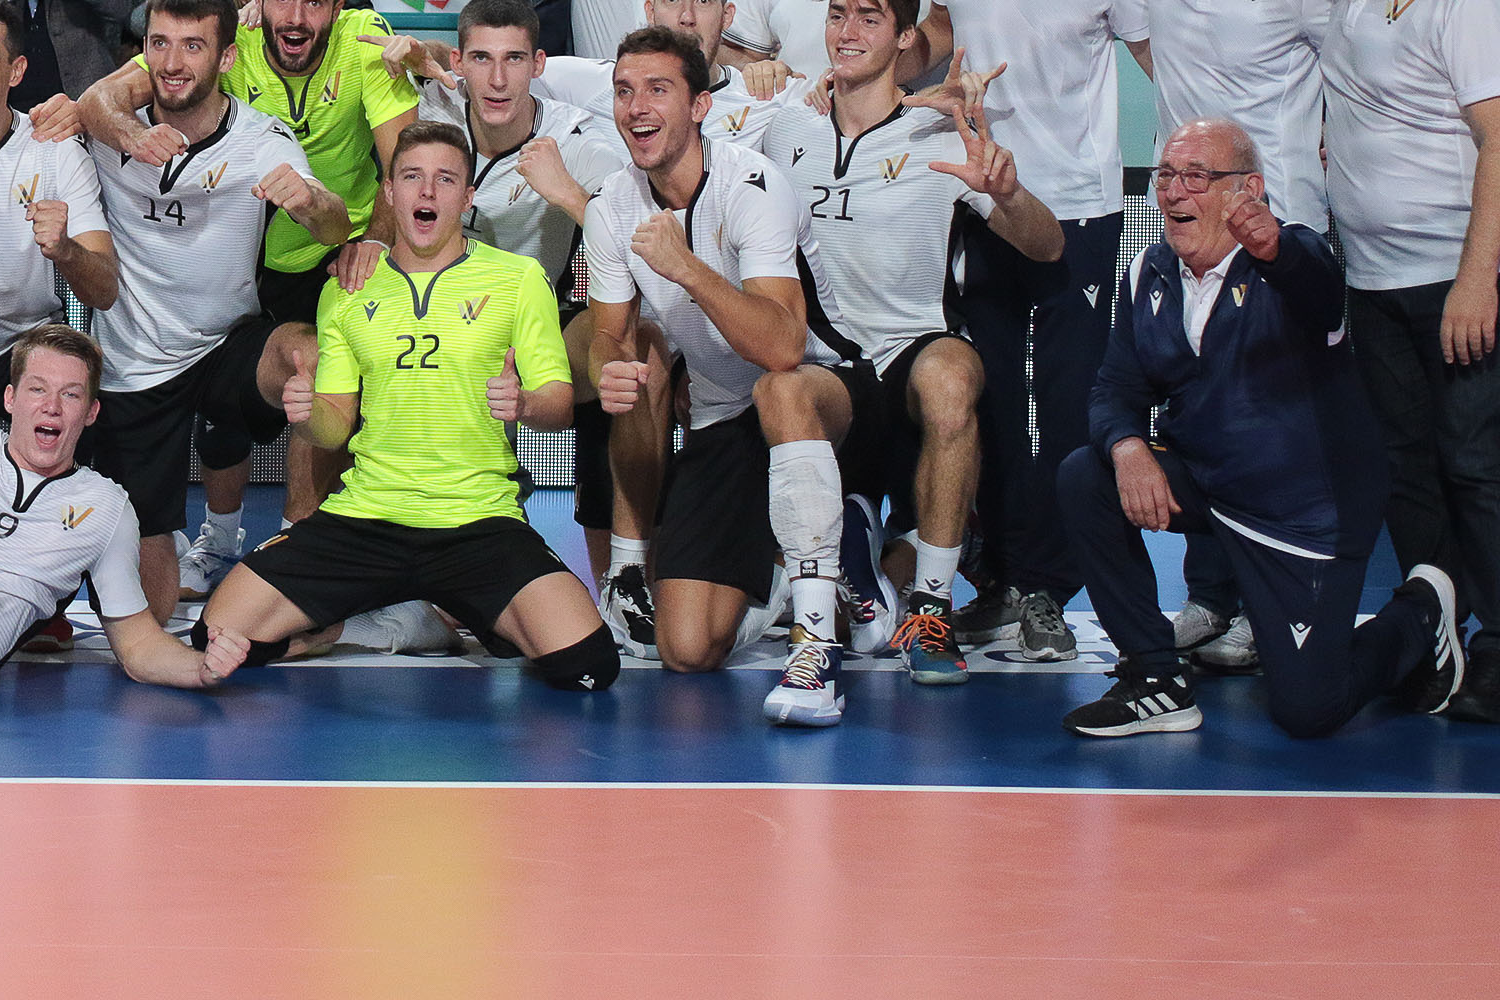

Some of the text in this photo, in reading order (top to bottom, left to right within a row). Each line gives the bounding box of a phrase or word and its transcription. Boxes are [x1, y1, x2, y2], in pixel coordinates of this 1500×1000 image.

[143, 195, 186, 227] 14
[810, 185, 854, 221] 21
[396, 333, 440, 369] 22
